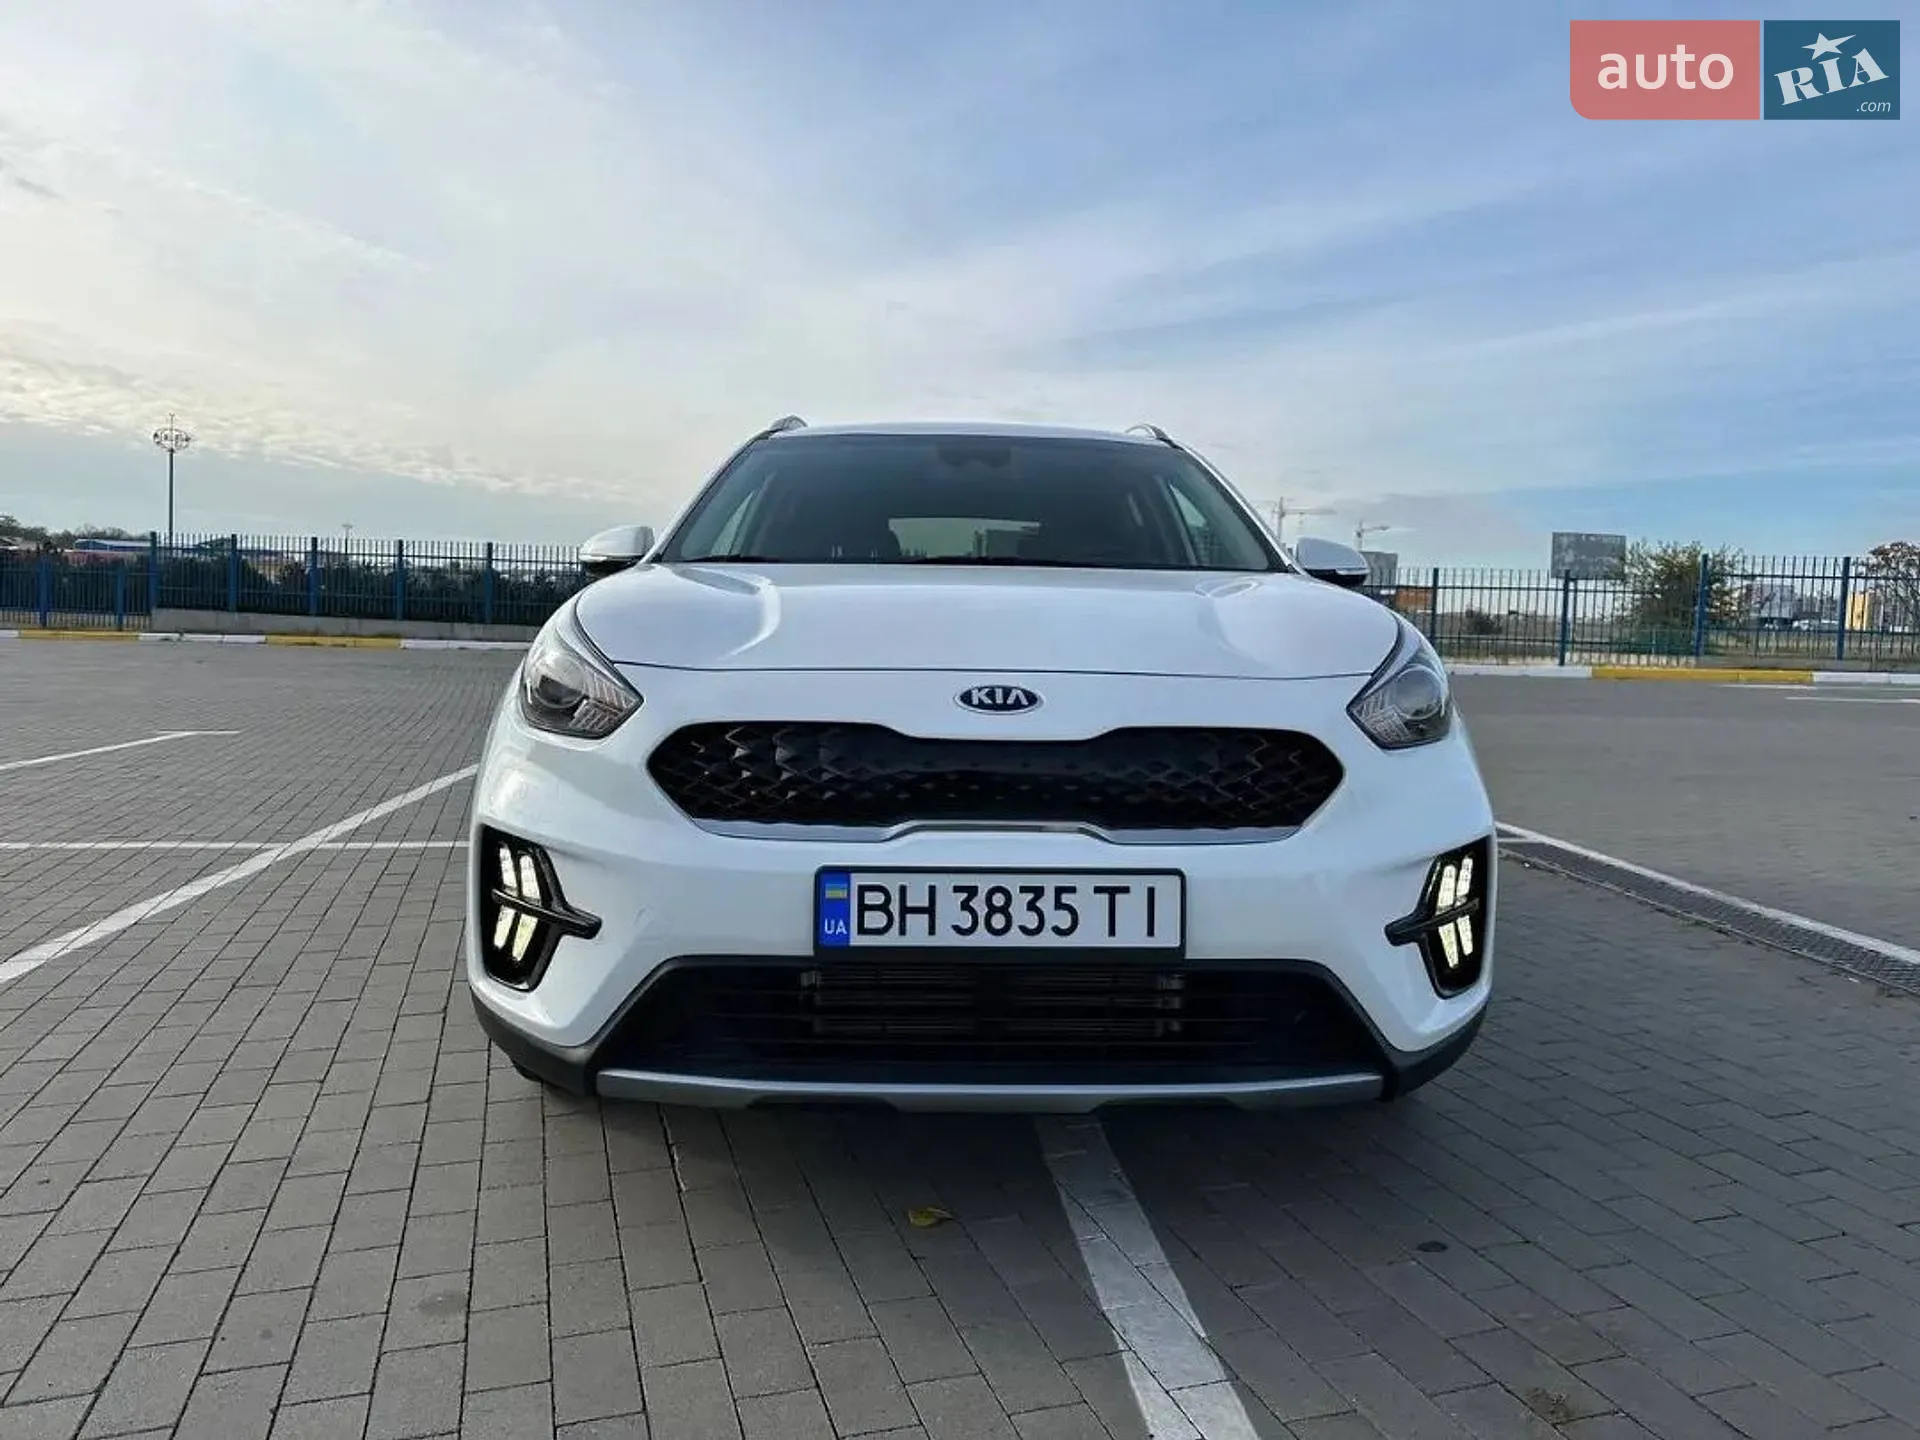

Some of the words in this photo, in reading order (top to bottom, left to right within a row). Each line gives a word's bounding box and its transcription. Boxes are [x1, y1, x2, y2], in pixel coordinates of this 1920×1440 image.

[971, 687, 1029, 705] KIA
[857, 884, 936, 936] BH
[951, 885, 1079, 937] 3835
[1093, 886, 1155, 938] TI
[824, 919, 848, 935] UA
